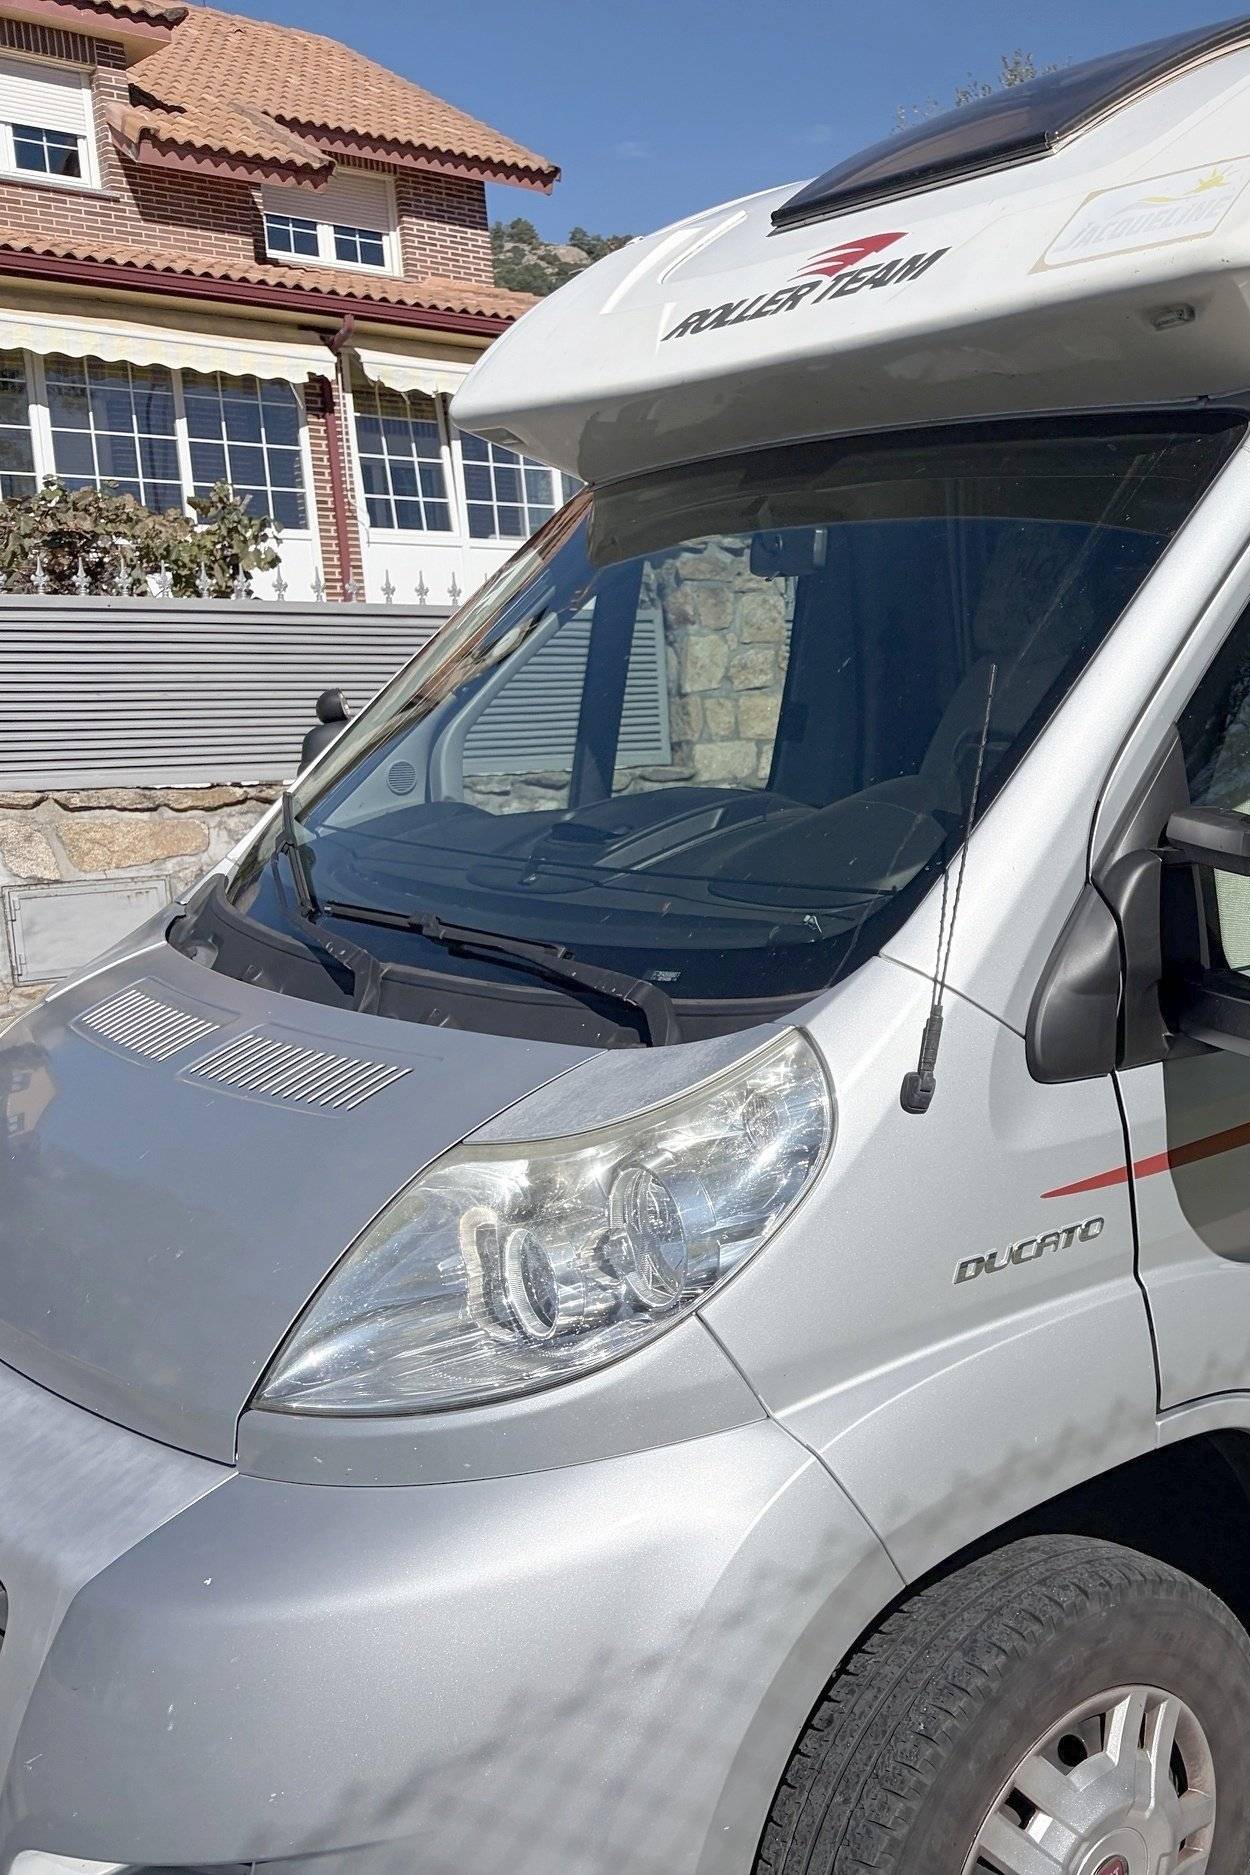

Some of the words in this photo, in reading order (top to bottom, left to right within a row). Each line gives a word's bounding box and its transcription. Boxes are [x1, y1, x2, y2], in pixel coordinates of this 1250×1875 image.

[661, 279, 823, 342] ROLLER
[811, 246, 952, 305] TEAM
[952, 1214, 1105, 1285] DUCATO
